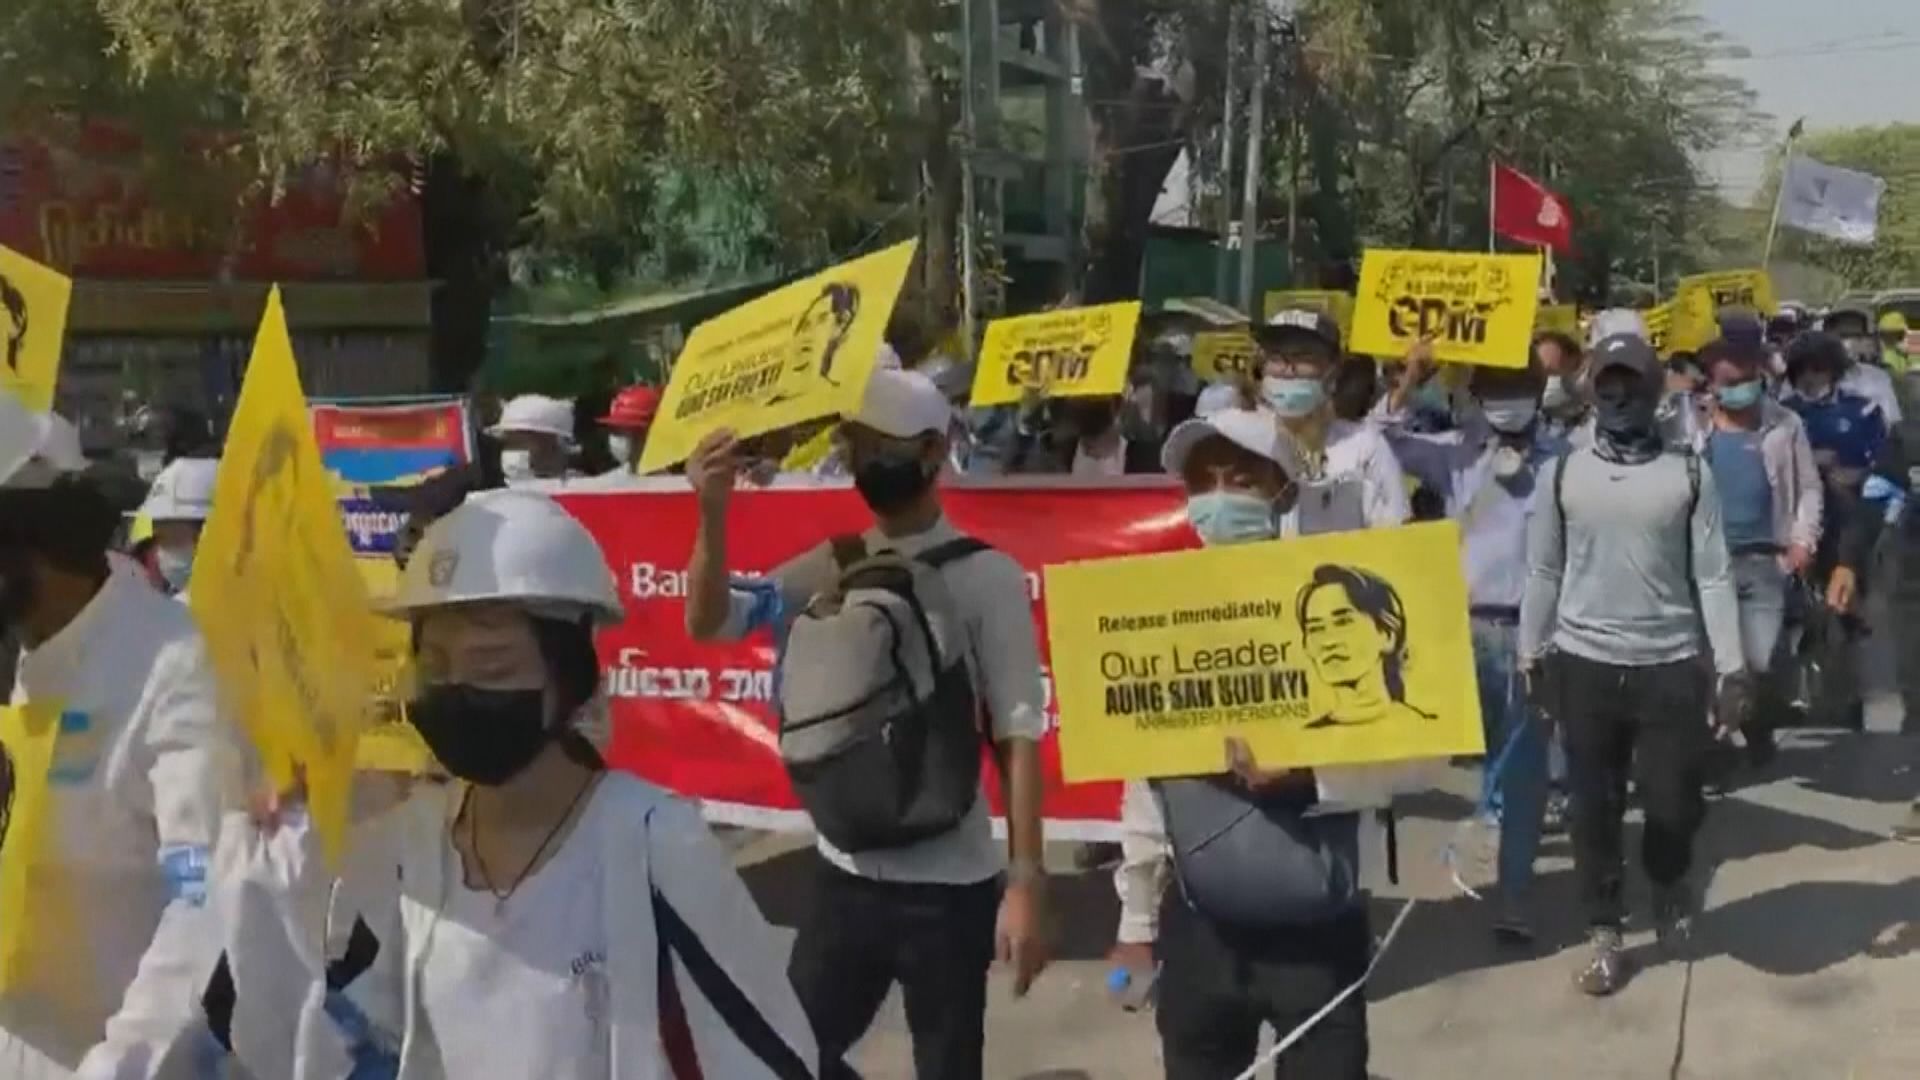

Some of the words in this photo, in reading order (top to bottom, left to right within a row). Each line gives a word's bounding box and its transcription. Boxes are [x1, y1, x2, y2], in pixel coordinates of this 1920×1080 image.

[1388, 296, 1487, 344] CDM
[1099, 612, 1168, 634] Release
[1171, 599, 1282, 626] immediately
[1100, 652, 1161, 682] Our
[1172, 639, 1292, 675] Leader
[1104, 681, 1164, 716] AUNG
[1167, 678, 1215, 711] SAN
[1269, 669, 1310, 701] KYI
[1222, 701, 1311, 725] PERSONS
